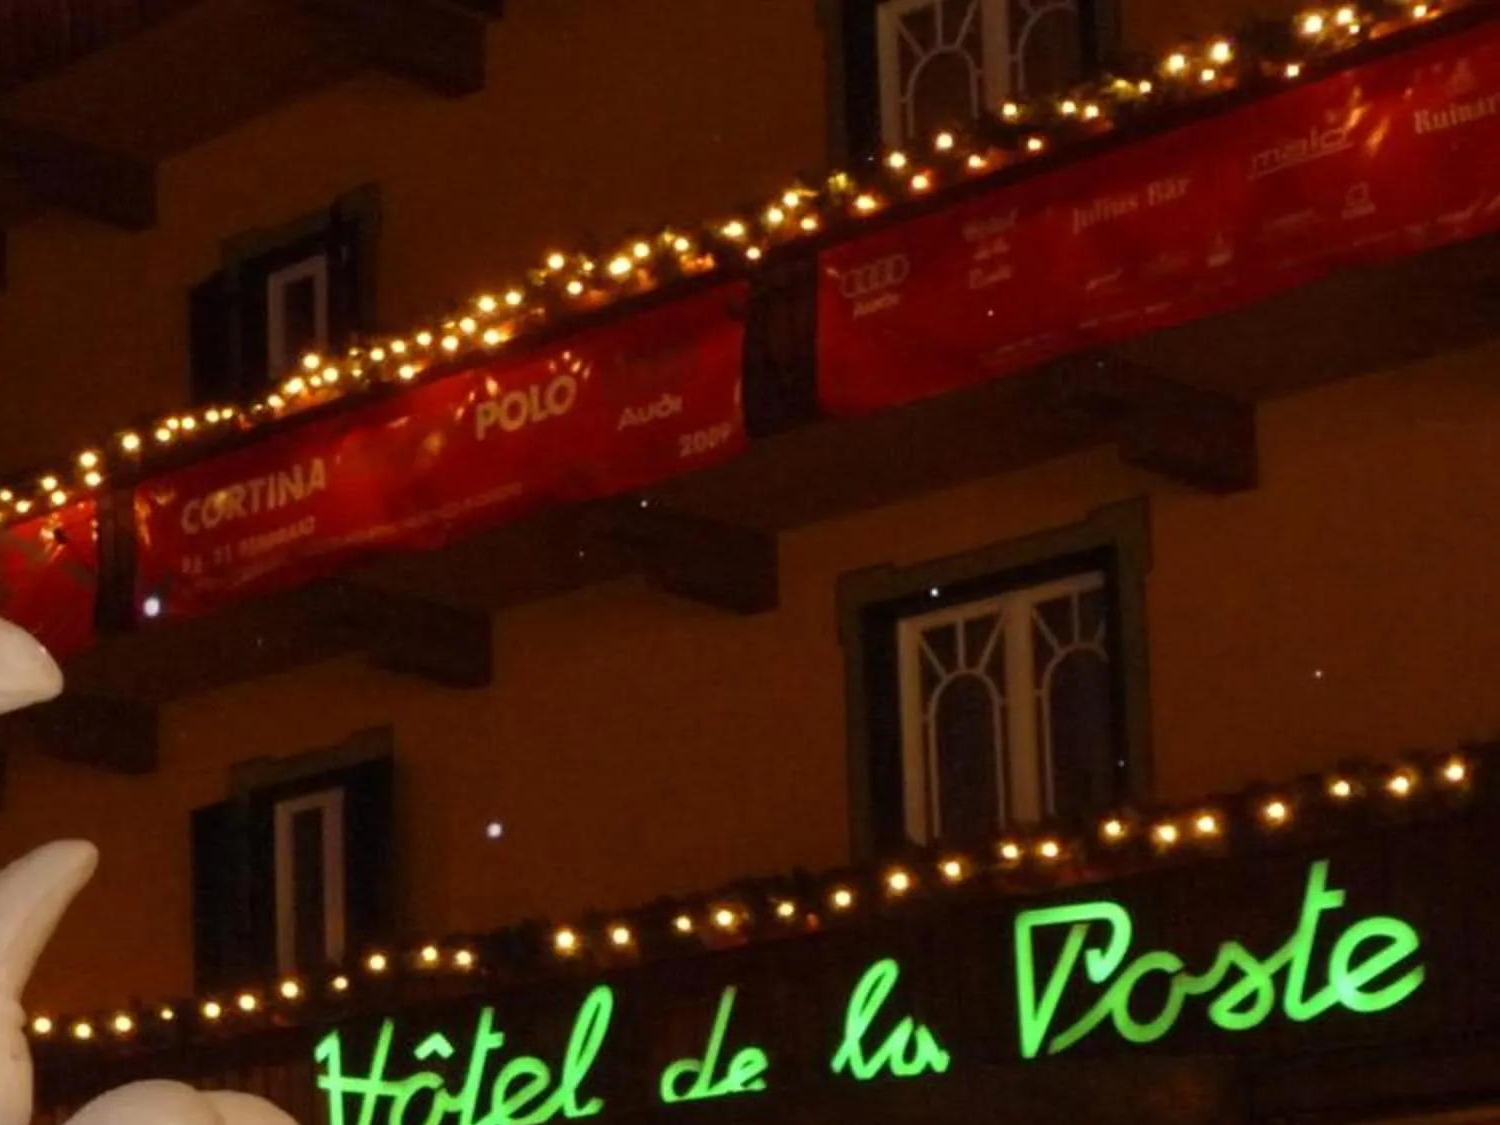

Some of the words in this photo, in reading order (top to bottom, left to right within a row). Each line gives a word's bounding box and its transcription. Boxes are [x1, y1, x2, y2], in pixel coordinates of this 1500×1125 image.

[476, 375, 577, 441] POLO
[617, 393, 683, 432] Audi
[180, 457, 326, 534] CORTINA
[659, 986, 769, 1104] de
[830, 958, 952, 1081] la
[1014, 859, 1427, 1060] Poste
